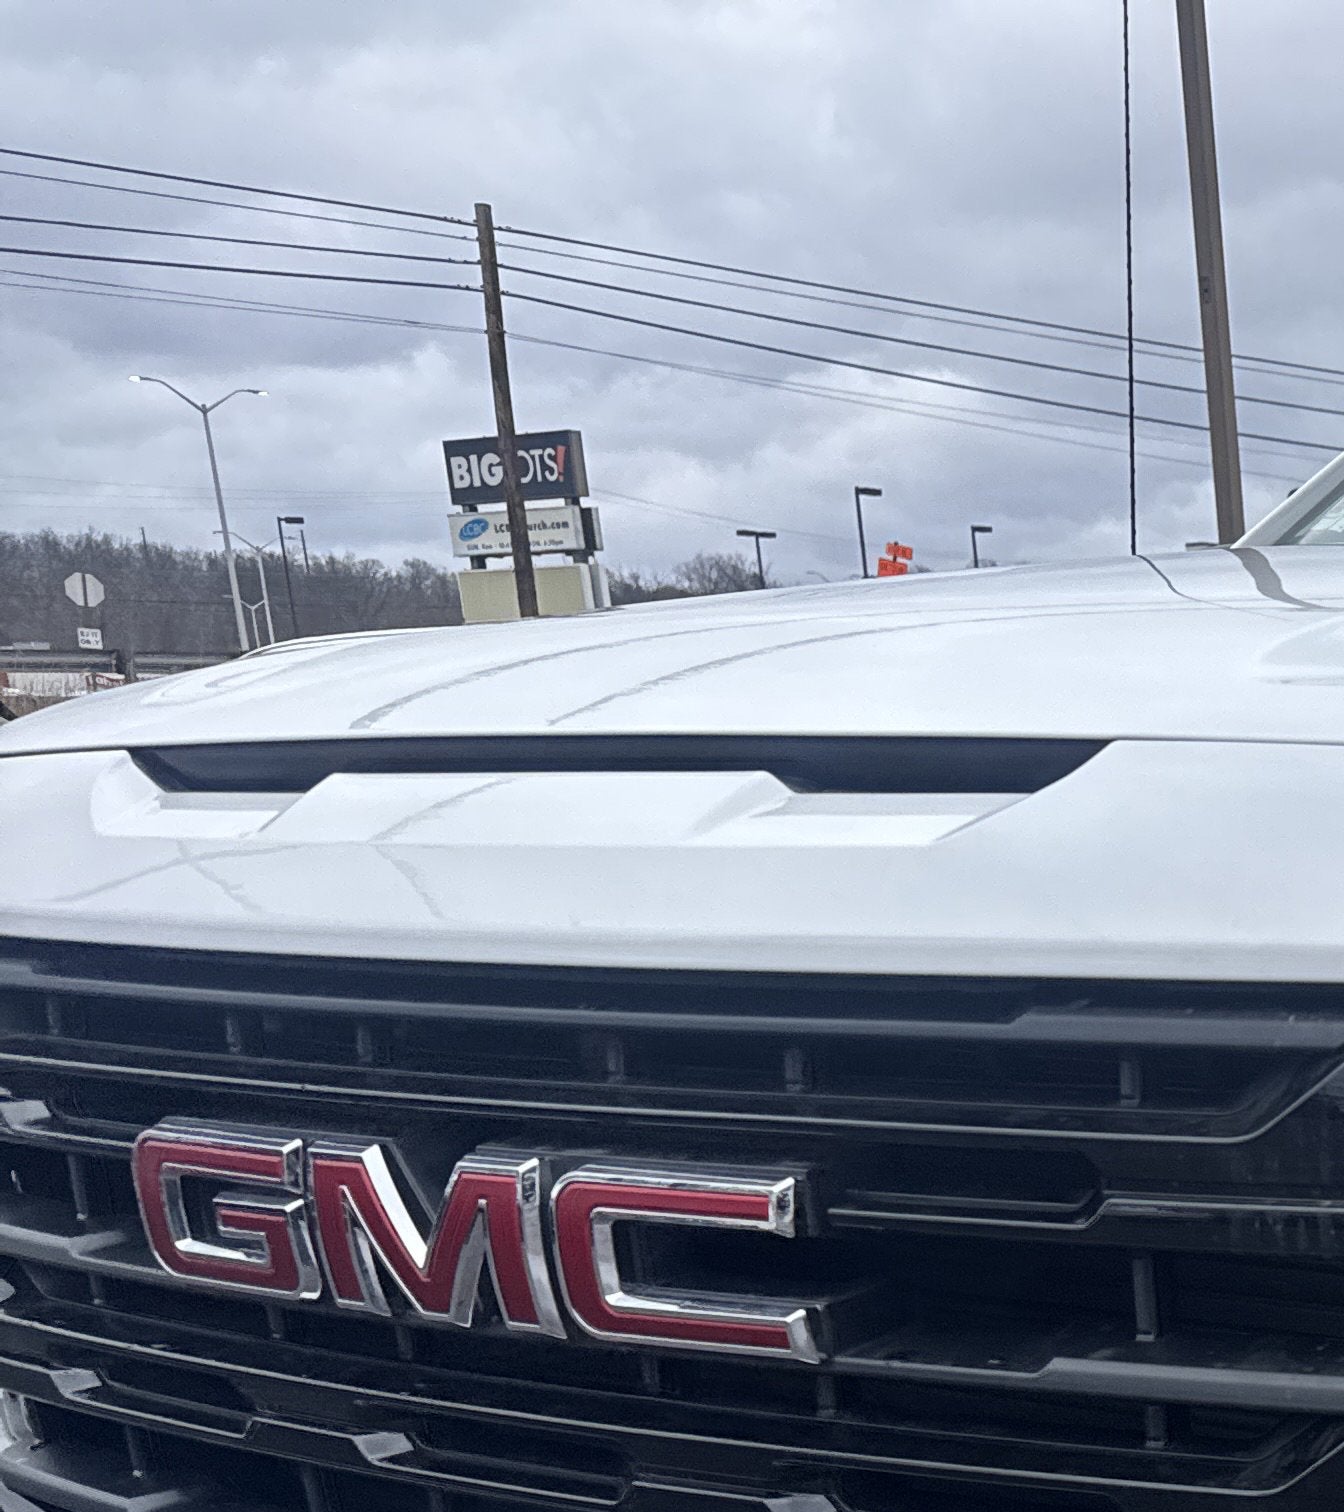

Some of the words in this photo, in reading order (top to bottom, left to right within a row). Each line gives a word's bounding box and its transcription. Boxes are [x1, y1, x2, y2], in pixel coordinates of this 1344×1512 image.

[450, 452, 504, 489] BIG
[516, 445, 566, 484] OTS!
[131, 1117, 828, 1364] GMC
